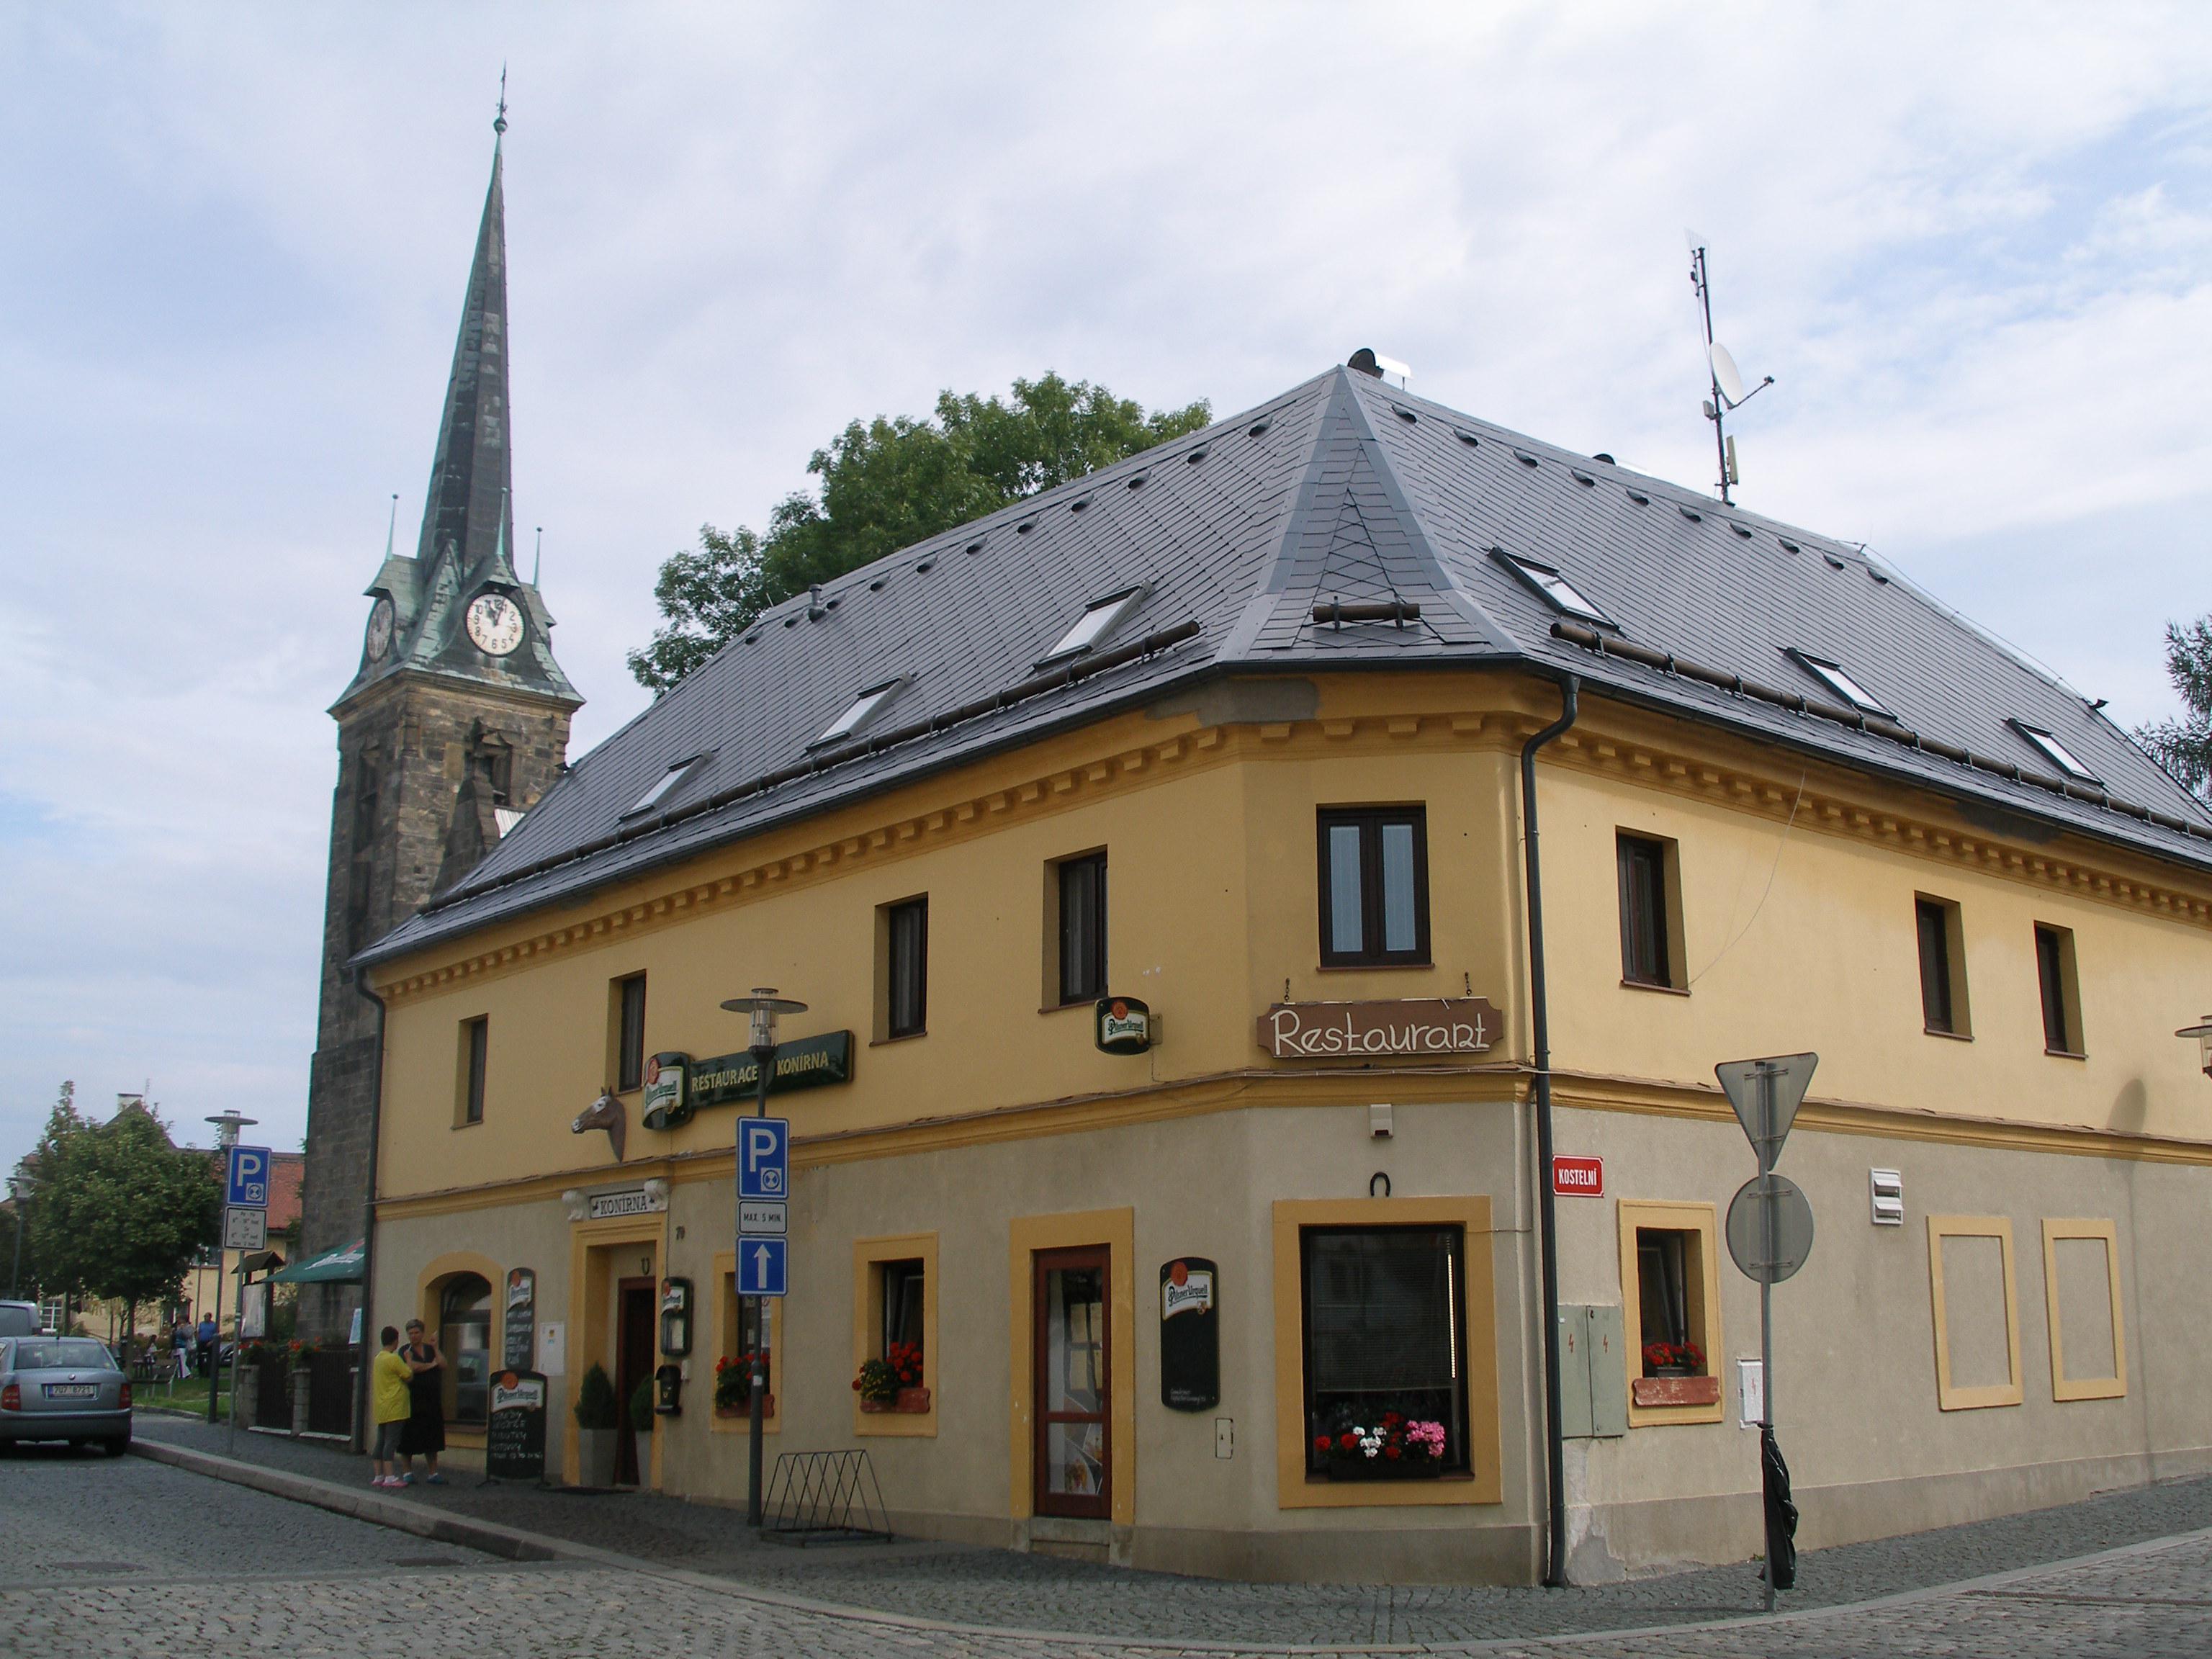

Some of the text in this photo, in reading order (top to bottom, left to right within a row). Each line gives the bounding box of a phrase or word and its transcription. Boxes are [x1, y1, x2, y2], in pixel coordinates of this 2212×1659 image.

[504, 603, 508, 613] 1
[474, 614, 480, 625] 9
[510, 611, 516, 621] 2
[475, 626, 480, 637] 8
[511, 622, 517, 633] 3
[482, 634, 487, 646] 7
[492, 638, 497, 649] 6
[501, 638, 507, 649] 5
[508, 634, 514, 644] 4
[1270, 1010, 1490, 1056] Restaurant
[691, 1051, 830, 1092] RESTAURACE KONÍRNA
[750, 1128, 777, 1172] P
[237, 1154, 261, 1187] P
[1558, 1167, 1598, 1186] KOSTELNÍ
[600, 1195, 648, 1215] KONÍRNA
[762, 1213, 767, 1223] 5
[1169, 1284, 1208, 1307] Pilsner Urquell
